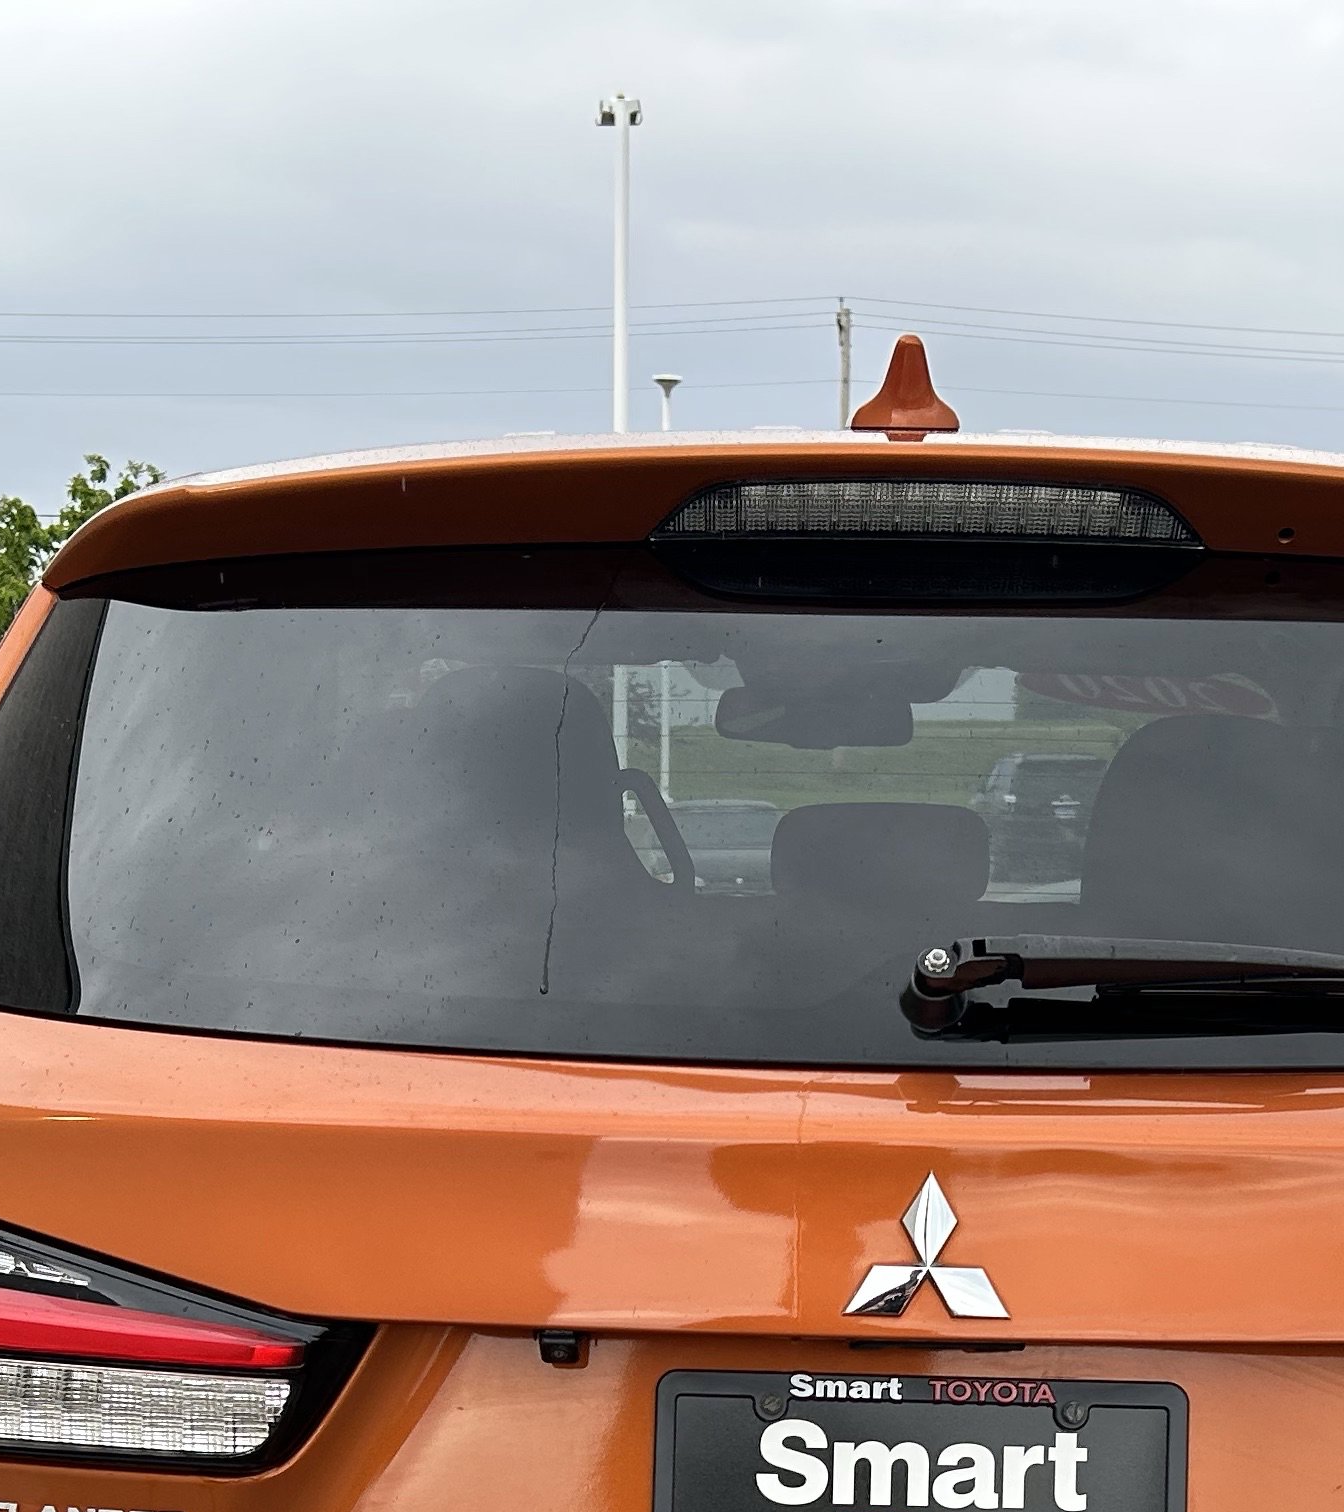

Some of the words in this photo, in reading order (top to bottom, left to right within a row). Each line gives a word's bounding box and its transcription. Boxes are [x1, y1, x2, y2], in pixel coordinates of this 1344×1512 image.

[789, 1374, 903, 1399] Smart
[929, 1380, 1056, 1404] TOYOTA
[756, 1419, 1088, 1512] Smart
